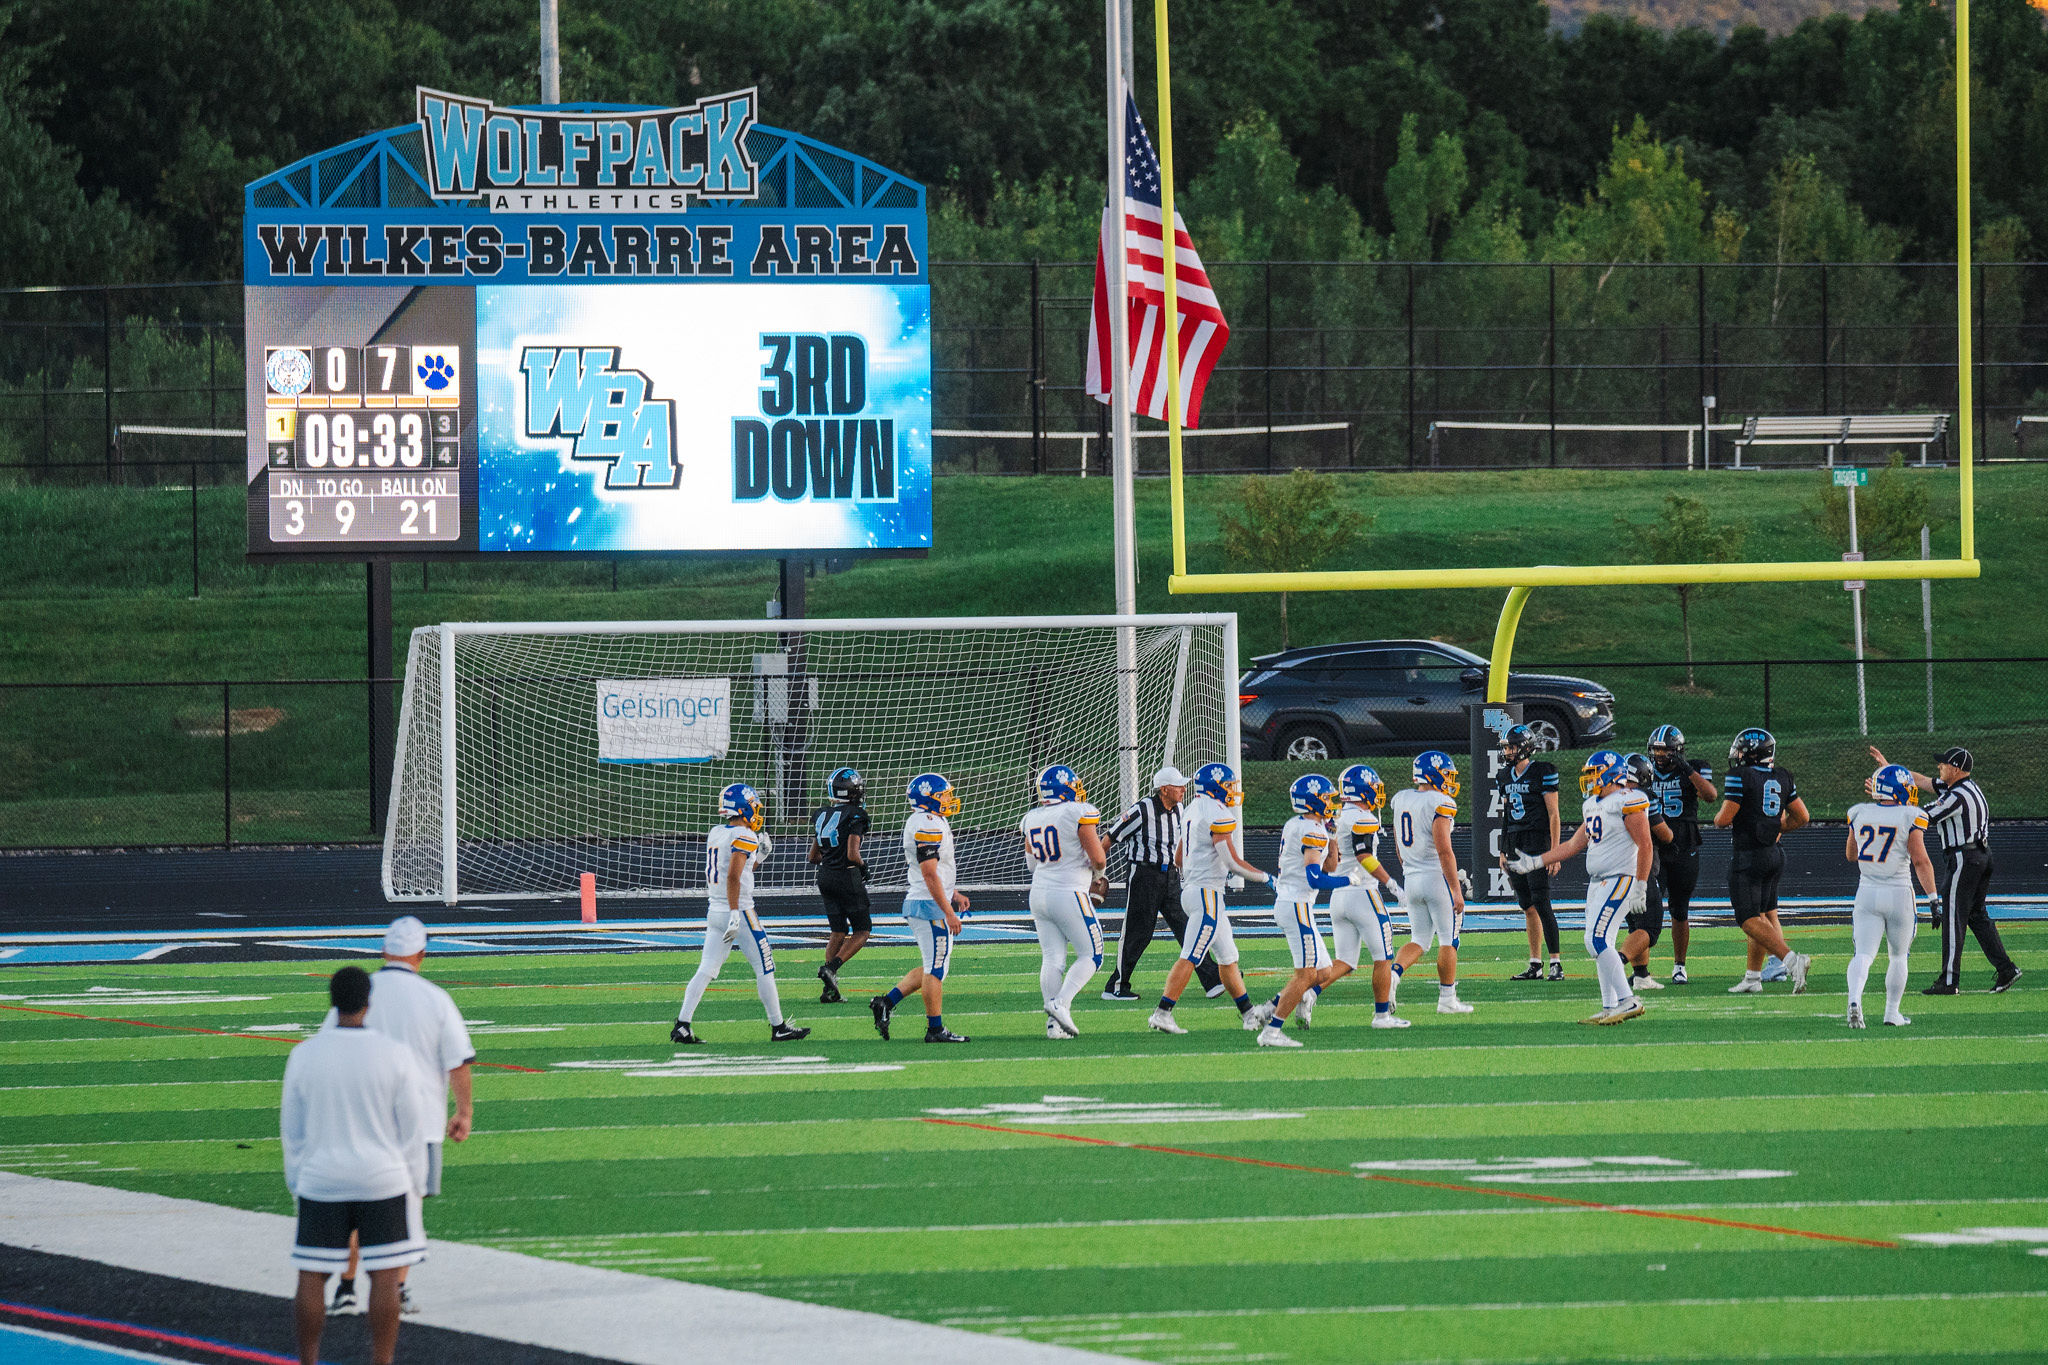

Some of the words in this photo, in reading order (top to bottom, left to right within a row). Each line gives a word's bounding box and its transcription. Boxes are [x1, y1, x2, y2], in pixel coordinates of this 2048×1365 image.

[423, 96, 753, 187] WOLFPACK
[495, 193, 684, 210] ATHLETICS
[258, 223, 734, 277] WILKES-BARRE
[751, 223, 919, 277] AREA
[327, 347, 346, 391] 0
[377, 347, 397, 391] 7
[758, 331, 869, 417] 3RD
[276, 417, 286, 432] 1
[438, 415, 451, 433] 3
[520, 346, 681, 490] WBA
[276, 448, 289, 465] 2
[305, 413, 423, 468] 09:33
[438, 446, 452, 464] 4
[731, 416, 899, 503] DOWN
[280, 479, 303, 496] DN
[316, 479, 337, 496] TO
[340, 479, 363, 496] GO
[381, 478, 420, 496] BALL
[422, 478, 447, 496] ON
[286, 500, 305, 535] 3
[335, 500, 355, 535] 9
[400, 500, 437, 534] 21
[603, 692, 724, 727] Geisinger
[1509, 792, 1527, 821] 3
[1762, 779, 1782, 817] 6
[816, 811, 842, 847] 14
[1029, 825, 1063, 863] 50
[1401, 811, 1414, 848] 0
[1585, 815, 1603, 844] 59
[1857, 825, 1898, 863] 27
[707, 847, 719, 884] 11
